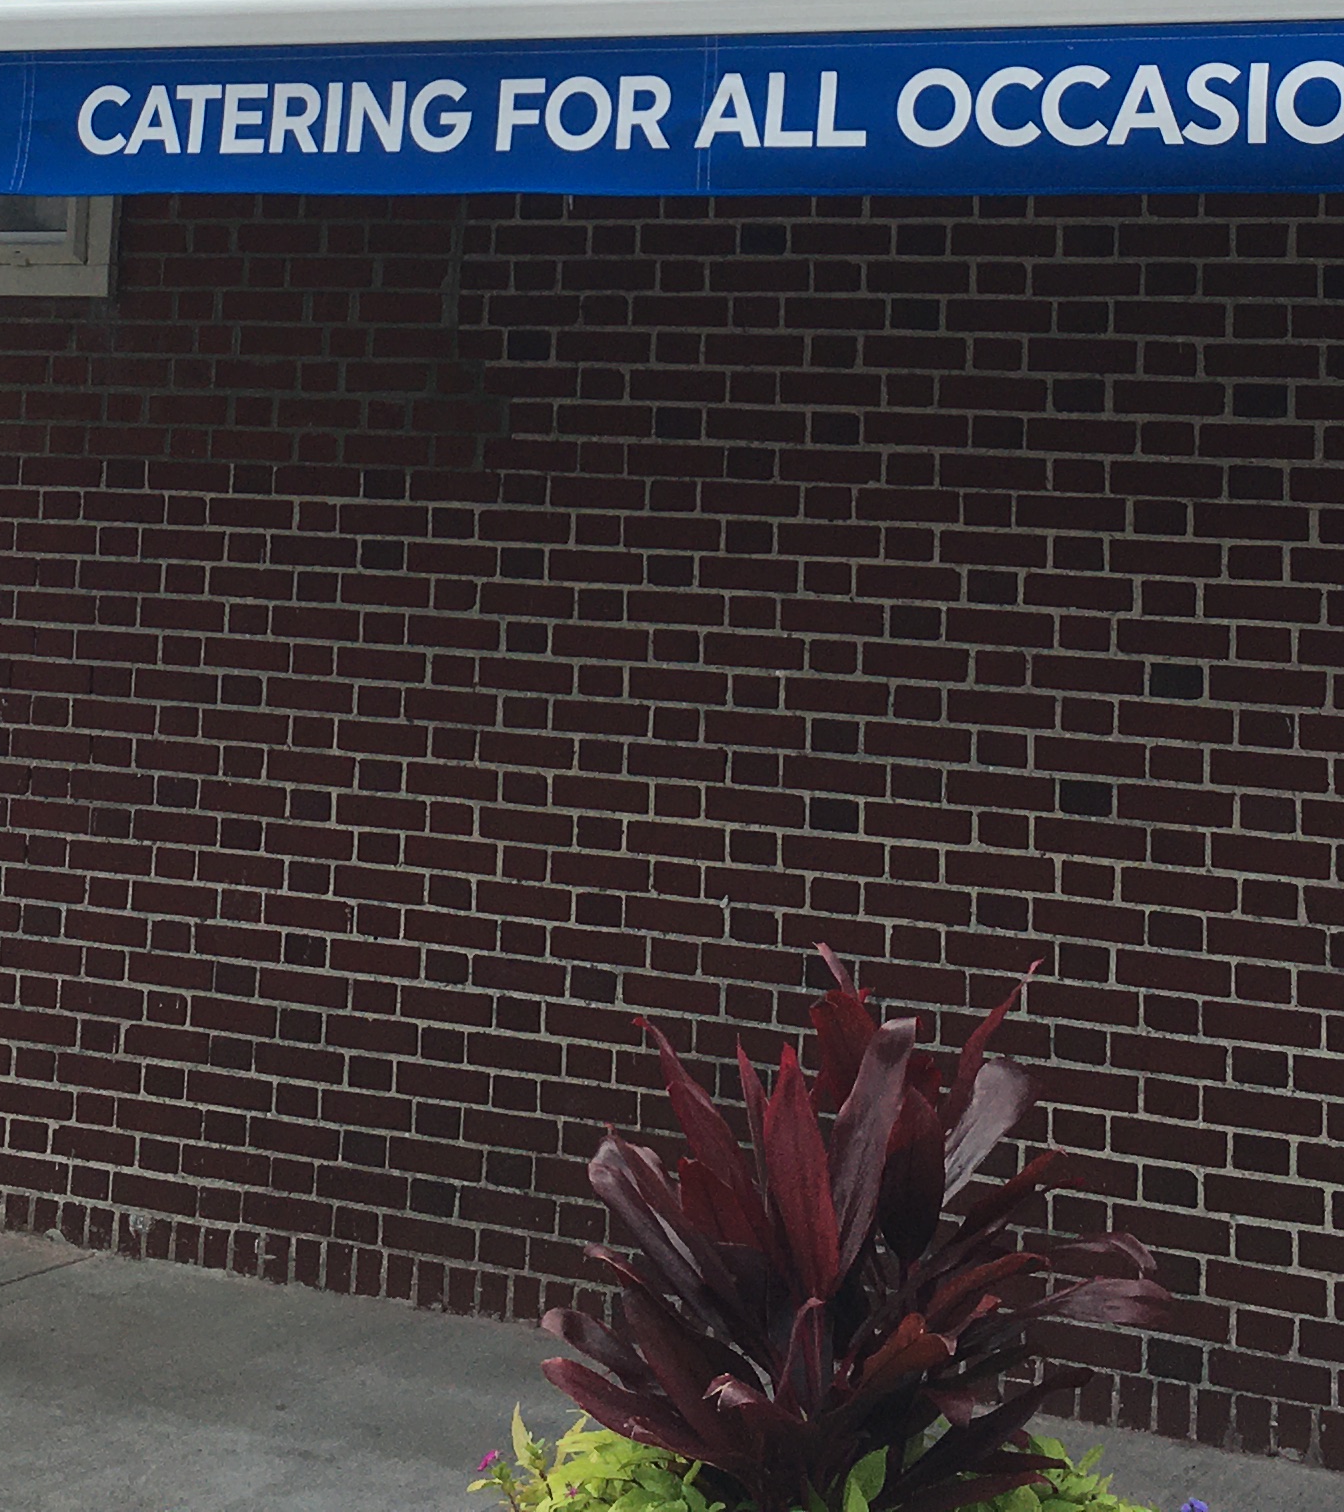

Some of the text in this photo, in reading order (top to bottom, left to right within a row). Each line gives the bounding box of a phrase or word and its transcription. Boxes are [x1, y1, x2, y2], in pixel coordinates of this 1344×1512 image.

[77, 79, 472, 156] CATERING
[495, 75, 672, 152] FOR
[693, 70, 867, 149] ALL
